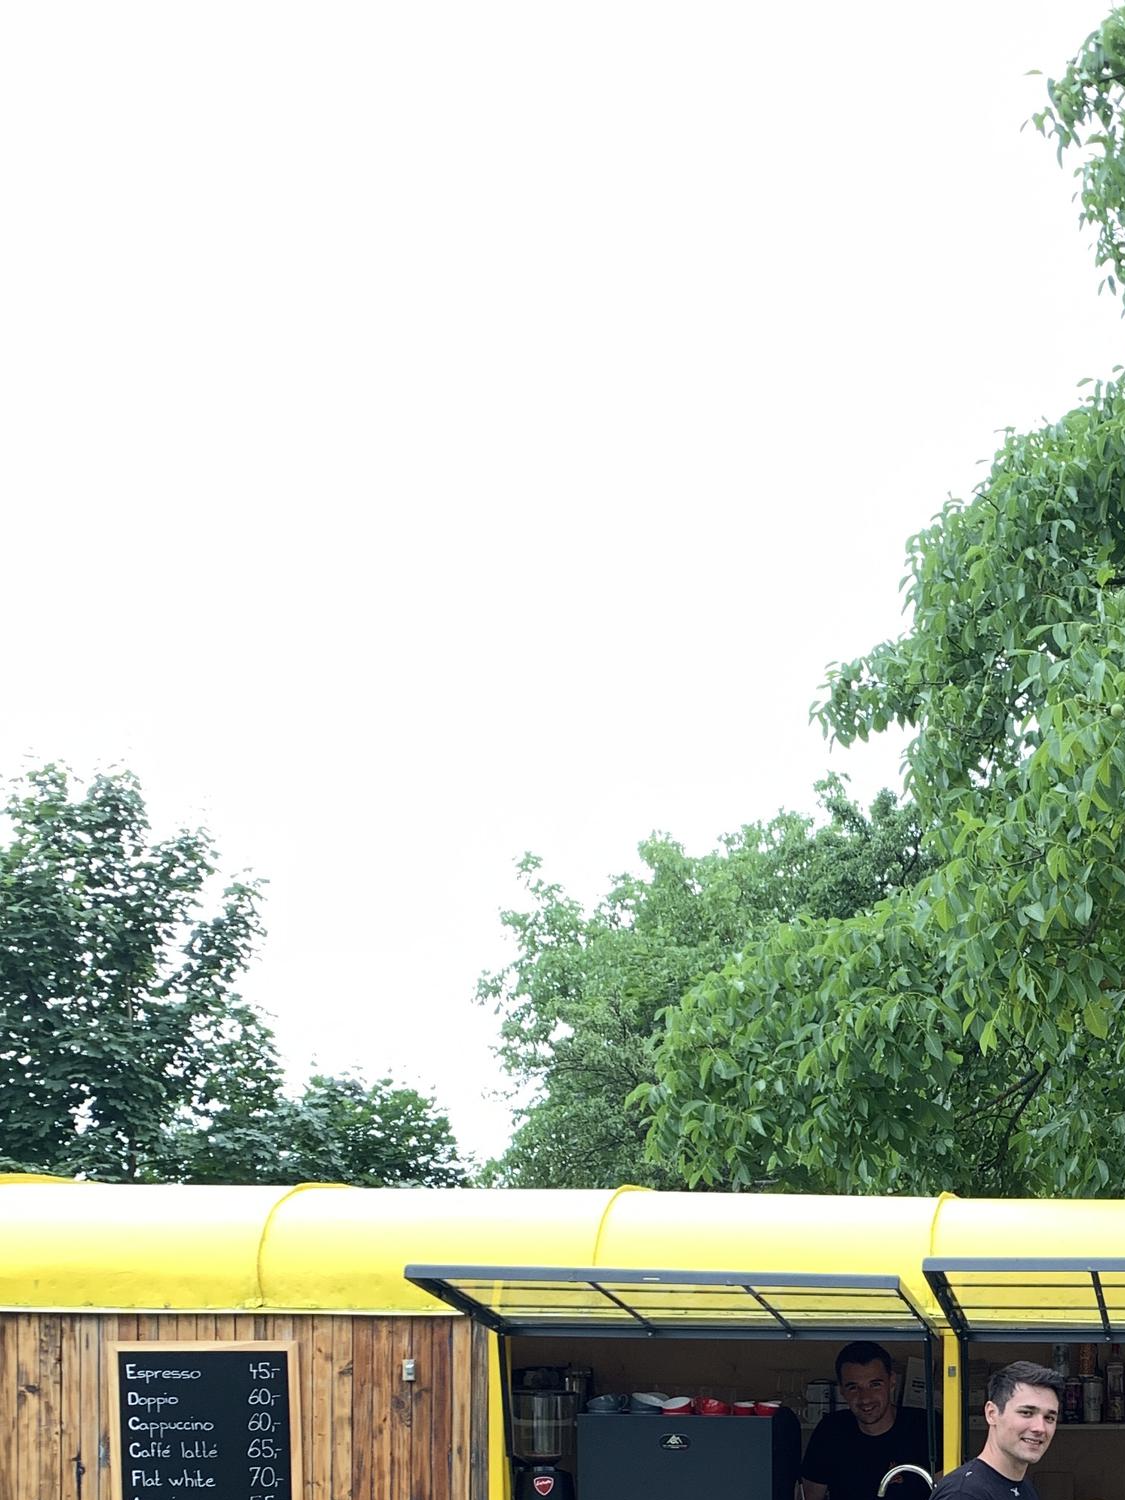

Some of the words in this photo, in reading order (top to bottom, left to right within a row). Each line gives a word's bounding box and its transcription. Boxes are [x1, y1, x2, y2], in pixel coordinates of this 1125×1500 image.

[125, 1363, 202, 1384] Espresso
[127, 1391, 179, 1413] Doppio
[247, 1387, 281, 1407] 60,-
[127, 1416, 215, 1439] Cappuccino
[247, 1411, 281, 1433] 60,-
[128, 1441, 171, 1459] Caffé
[247, 1438, 282, 1459] 65,-
[131, 1469, 163, 1487] Flat
[167, 1468, 217, 1488] white
[249, 1466, 284, 1488] 70,-
